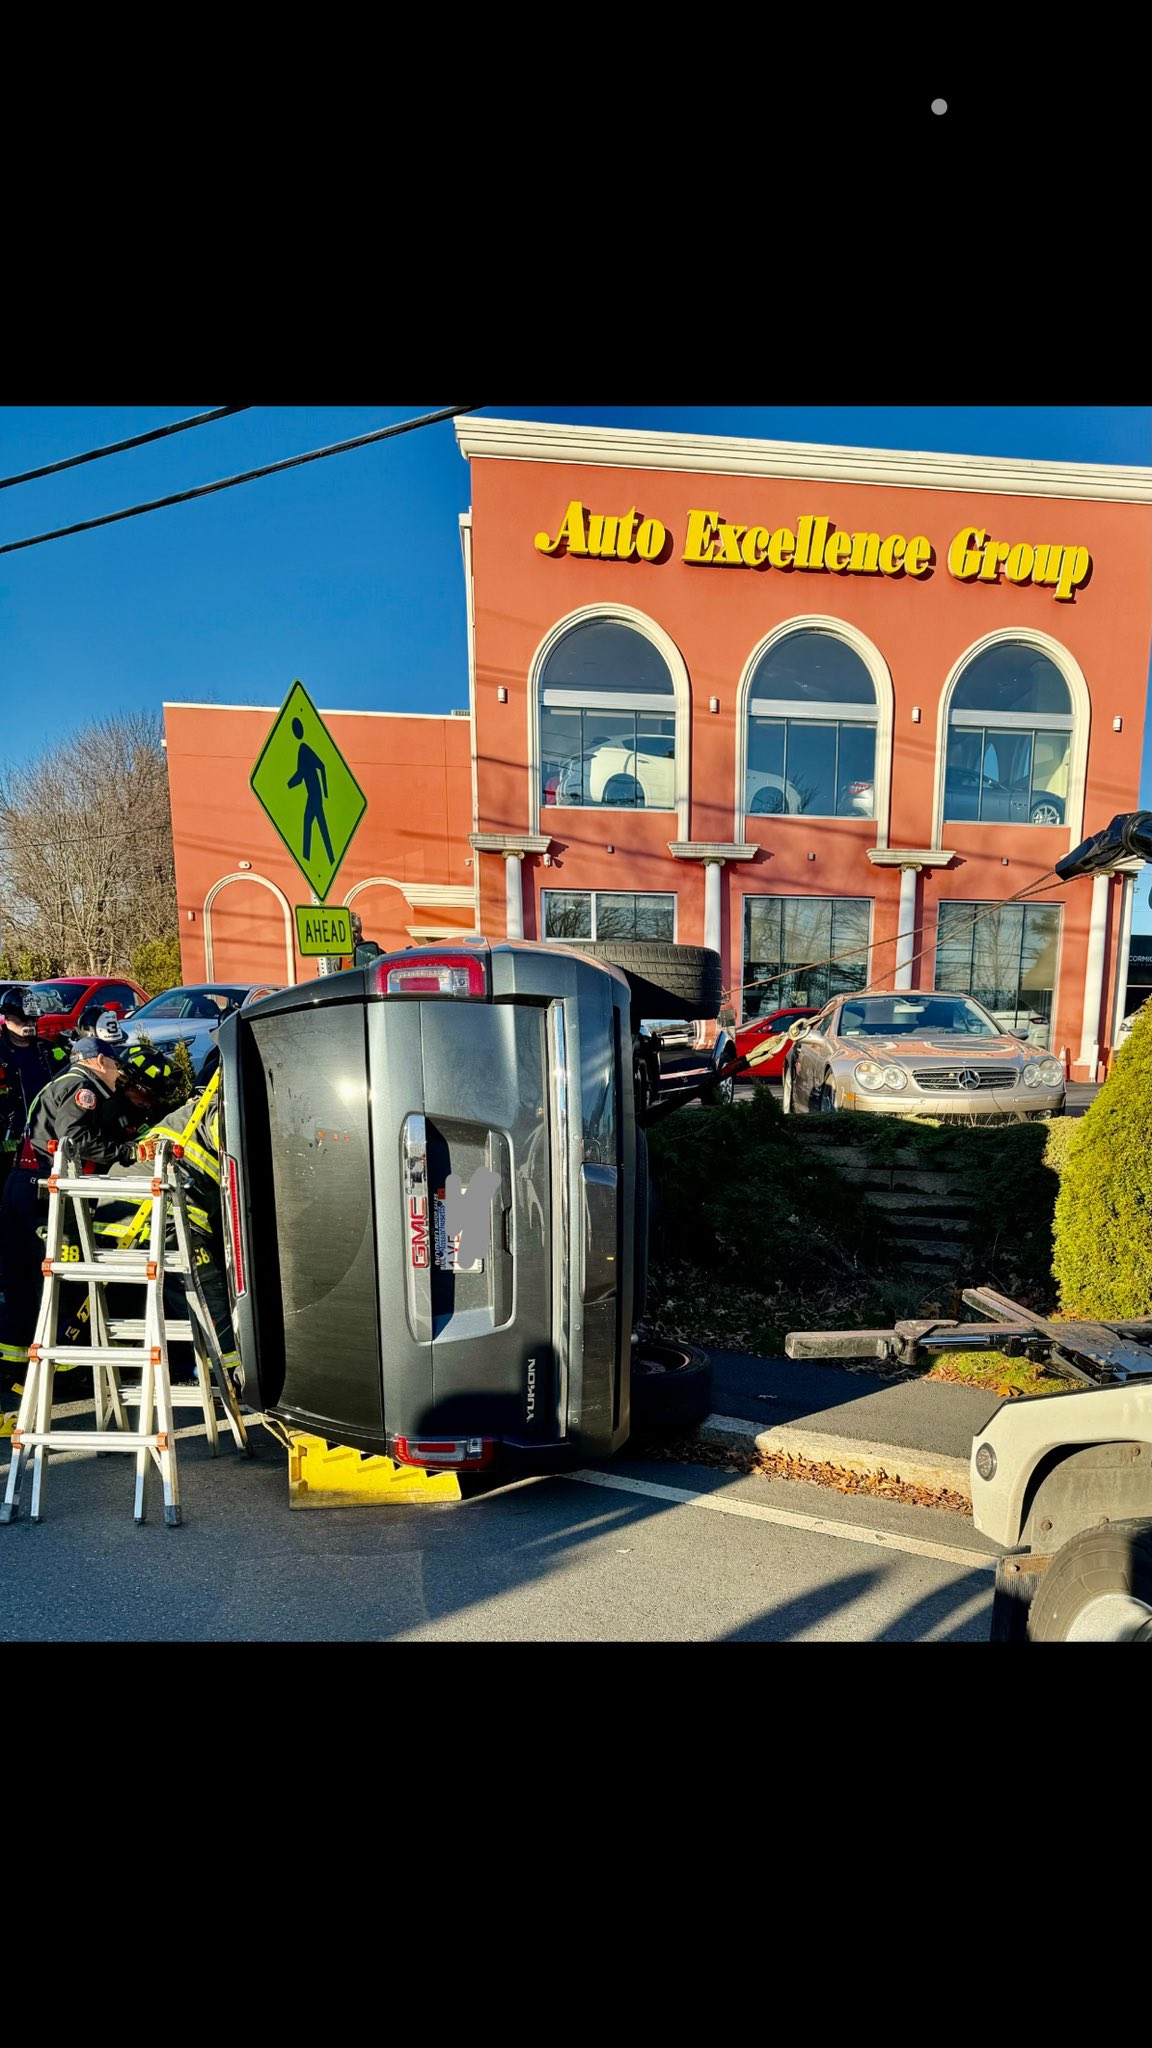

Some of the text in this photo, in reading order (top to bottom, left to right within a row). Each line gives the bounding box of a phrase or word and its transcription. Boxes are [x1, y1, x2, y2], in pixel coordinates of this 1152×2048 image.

[534, 500, 1090, 599] Auto Excellence Group
[305, 919, 346, 943] AHEAD
[106, 1021, 118, 1034] 3
[410, 1196, 428, 1268] GMC
[526, 1359, 536, 1423] YUKON
